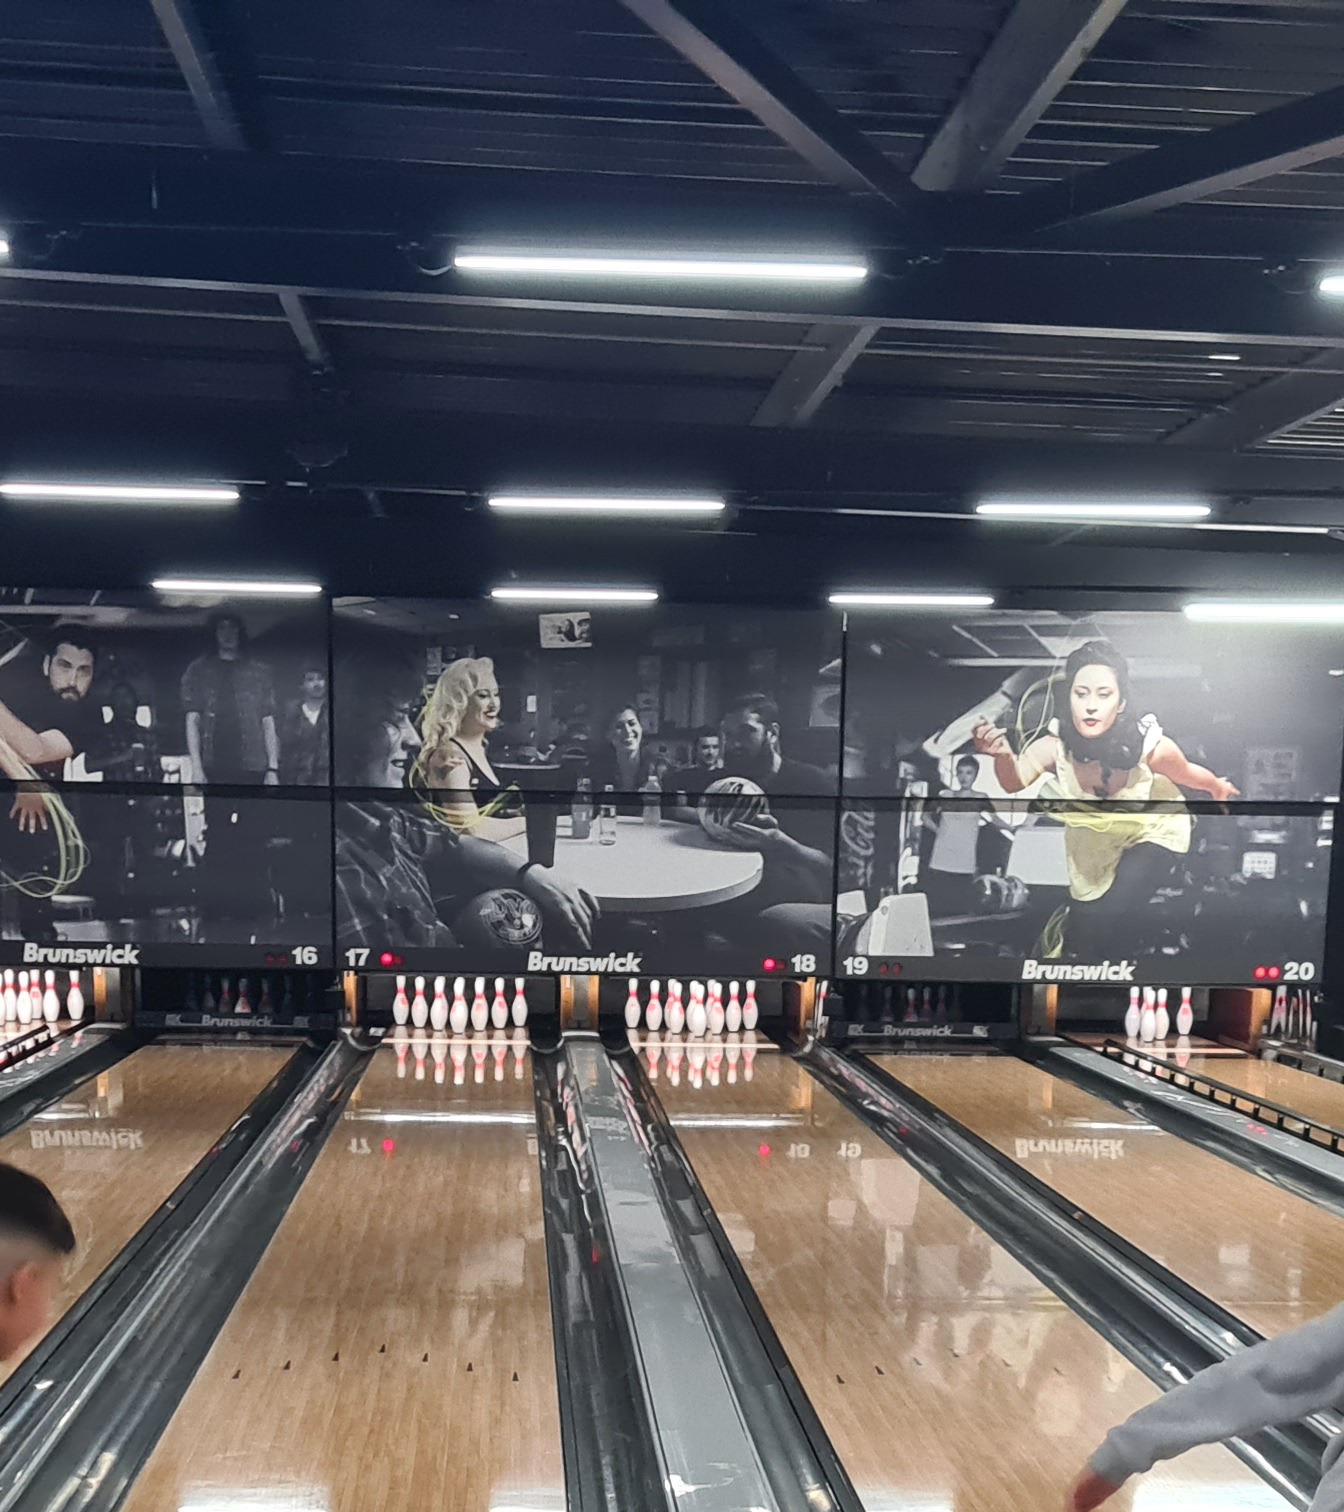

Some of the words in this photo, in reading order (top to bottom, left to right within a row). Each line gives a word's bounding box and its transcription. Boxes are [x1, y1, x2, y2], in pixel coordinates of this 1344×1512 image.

[22, 942, 140, 966] Brunswick
[291, 946, 318, 965] 16
[344, 947, 371, 967] 17
[527, 951, 643, 974] Brunswick
[790, 953, 817, 973] 18
[842, 956, 870, 976] 19
[1021, 959, 1136, 982] Brunswick
[1283, 961, 1315, 981] 20
[202, 1014, 273, 1027] Brunswick
[883, 1024, 953, 1037] Brunswick
